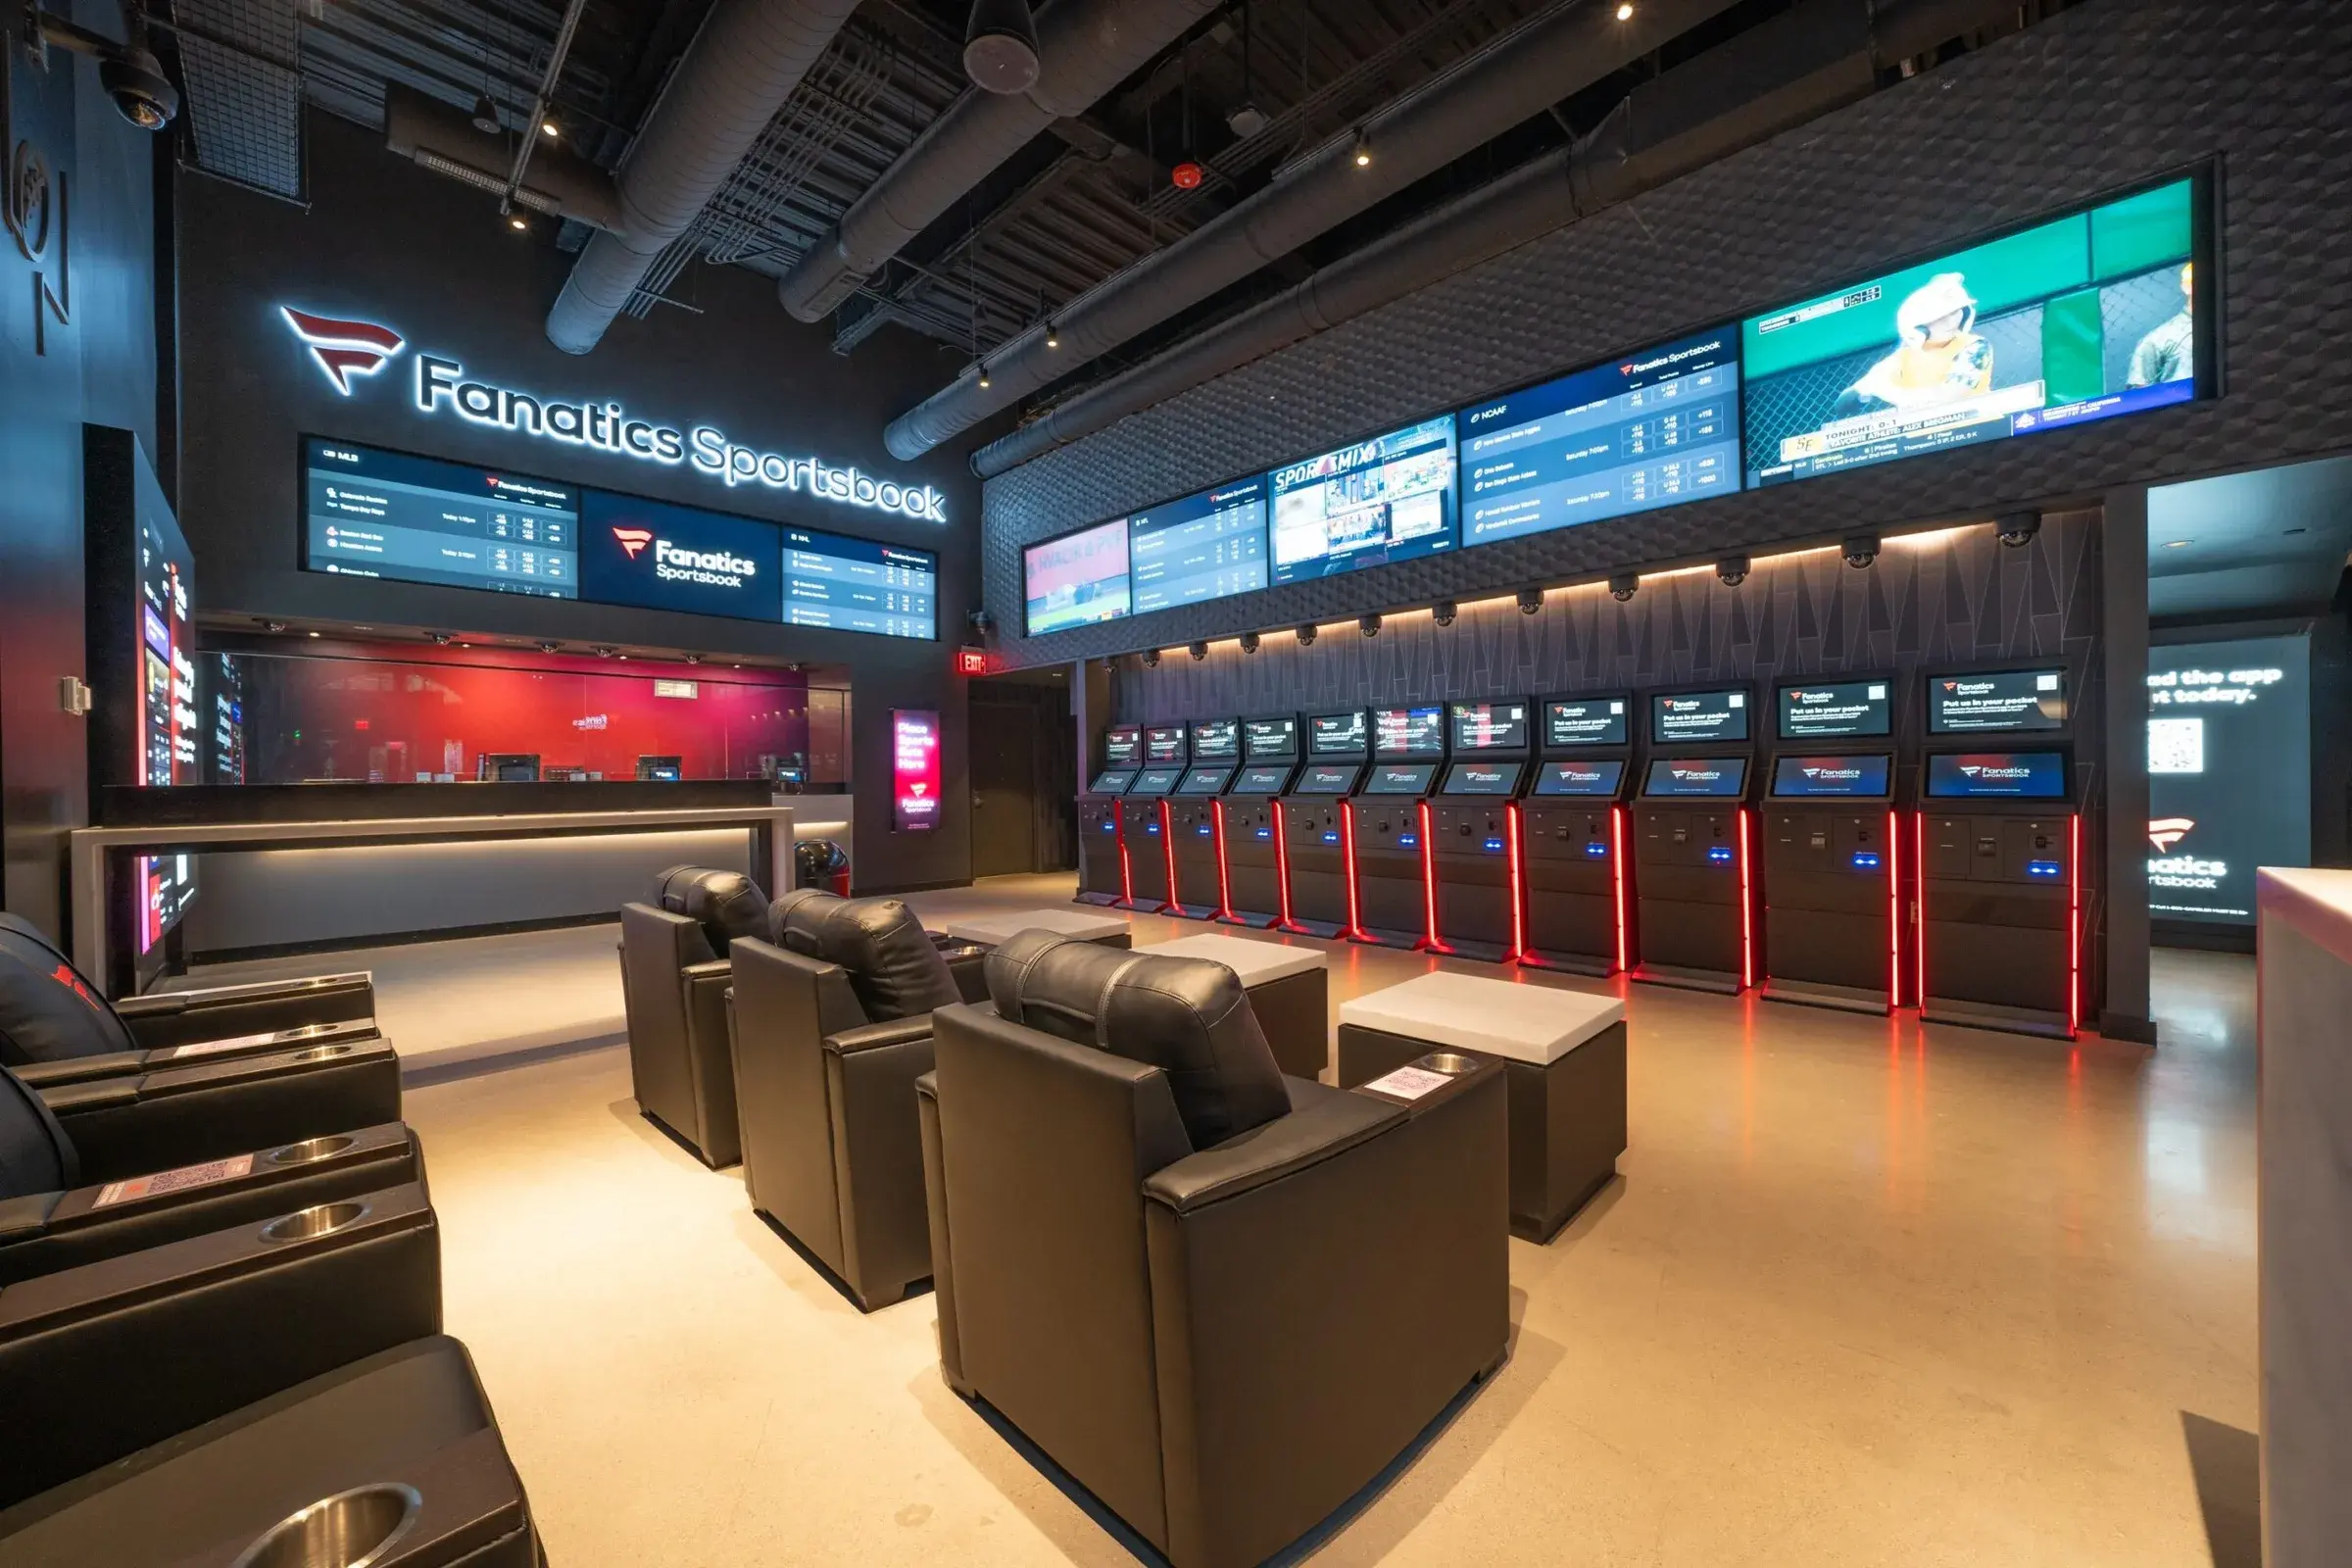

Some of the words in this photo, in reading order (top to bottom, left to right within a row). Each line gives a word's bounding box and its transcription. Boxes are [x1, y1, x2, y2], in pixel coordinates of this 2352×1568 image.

[1633, 357, 1668, 373] Fanatics
[1669, 341, 1721, 363] Sportsbook
[1481, 405, 1507, 420] NCAAF
[418, 356, 681, 460] Fanatics
[692, 428, 946, 522] Sportsbook
[337, 452, 359, 463] MLB
[1566, 450, 1589, 461] Saturday
[1274, 447, 1371, 488] SPORSMIX
[527, 487, 566, 500] Sportsbook
[1567, 496, 1589, 506] Saturday
[656, 540, 756, 576] Fanatics
[657, 563, 742, 588] Sportsbook
[964, 655, 982, 671] EXIT
[2180, 669, 2224, 685] the
[2229, 668, 2282, 685] app
[1956, 682, 1995, 691] Fanatics
[2174, 686, 2257, 705] today.
